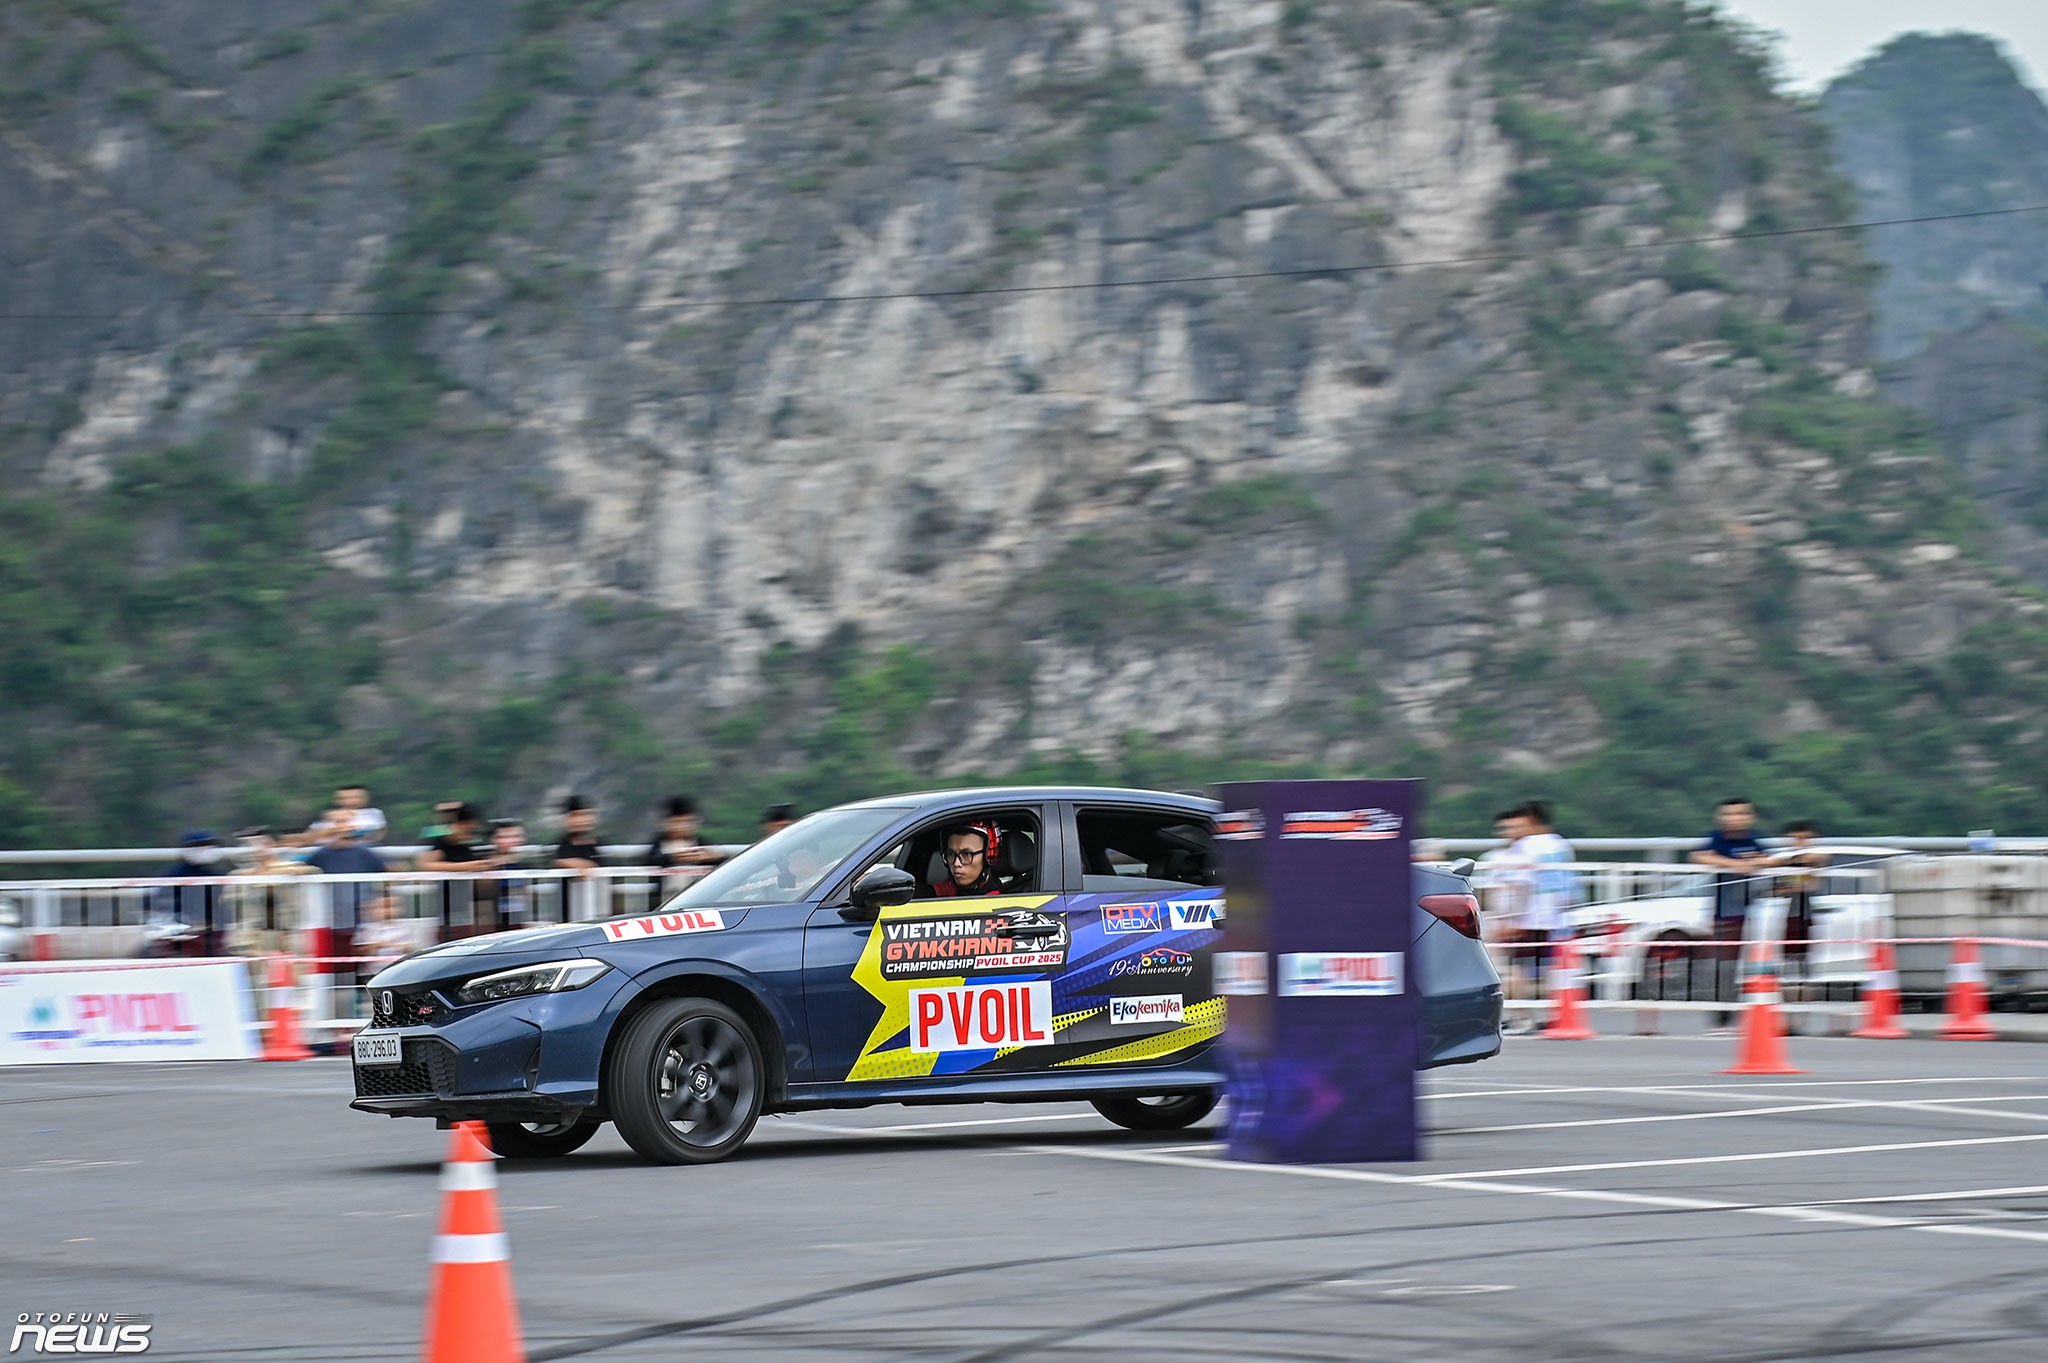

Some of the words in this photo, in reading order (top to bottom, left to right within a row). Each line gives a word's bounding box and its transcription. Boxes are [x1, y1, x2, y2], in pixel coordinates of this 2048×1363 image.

[1106, 904, 1155, 919] OTV
[887, 919, 980, 940] VIETNAM
[1107, 917, 1159, 930] MEDIA
[886, 937, 1013, 960] GYMKHANA
[886, 958, 974, 974] CHAMPIONSHIP
[976, 957, 1009, 967] PVOIL
[1012, 955, 1035, 965] CUP
[1037, 953, 1062, 963] 2025
[1126, 961, 1193, 977] Anniversary
[918, 987, 1045, 1047] PVOIL
